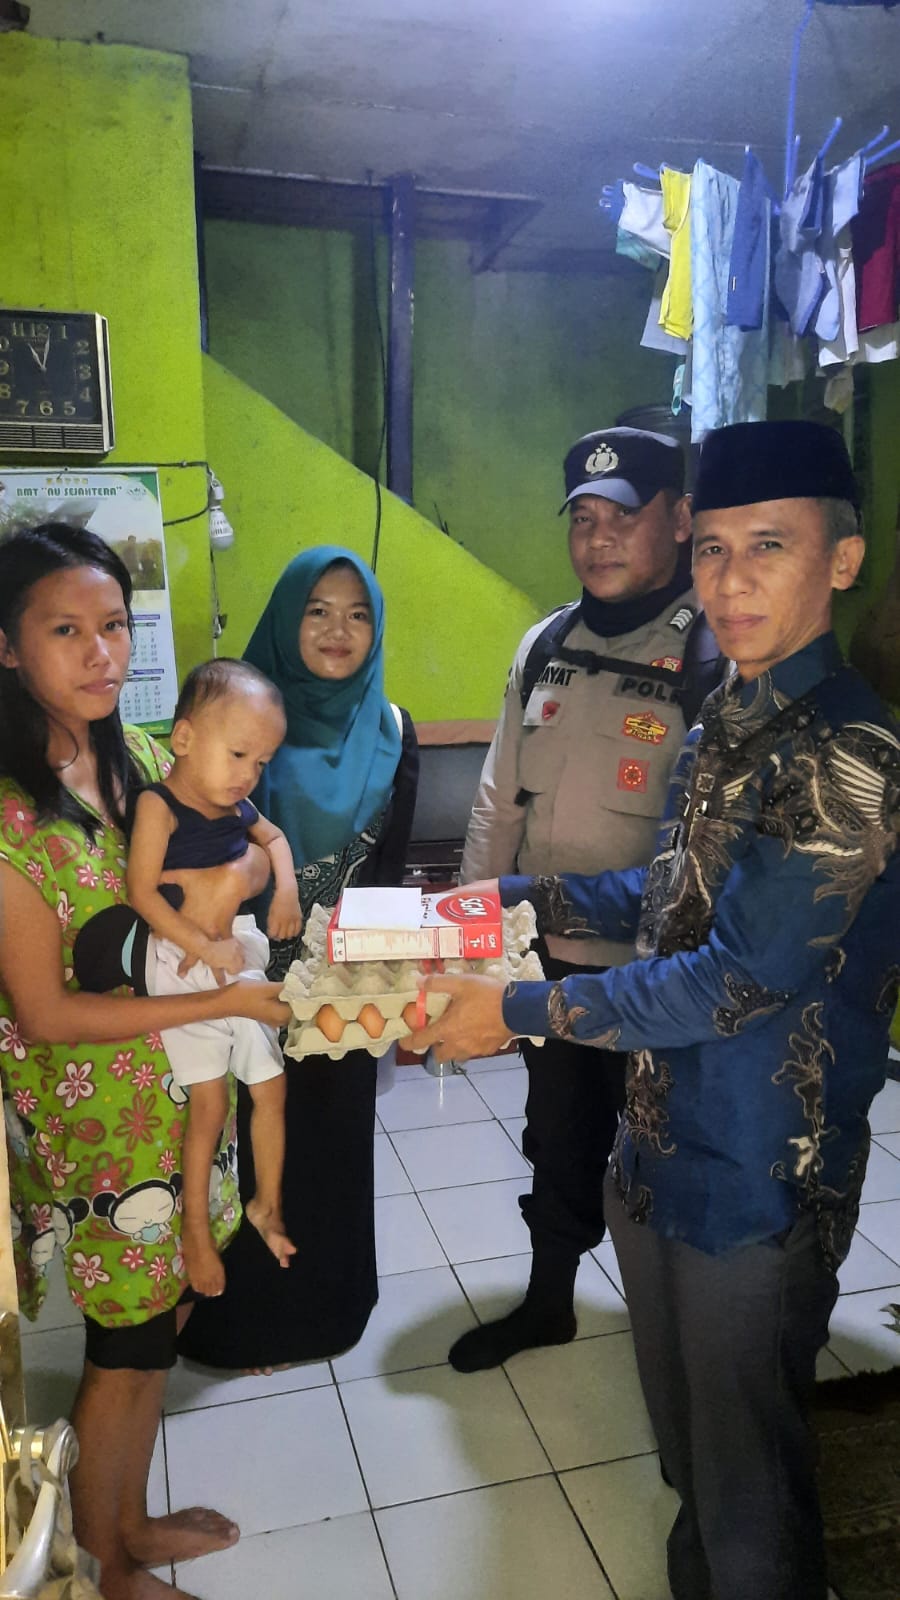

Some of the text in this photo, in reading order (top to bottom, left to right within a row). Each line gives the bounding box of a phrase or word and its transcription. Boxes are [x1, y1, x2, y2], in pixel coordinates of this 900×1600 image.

[60, 325, 68, 340] 1
[76, 340, 90, 355] 2
[79, 364, 92, 380] 3
[80, 387, 91, 402] 4
[16, 400, 76, 416] 7 6 5
[460, 897, 488, 916] SGM
